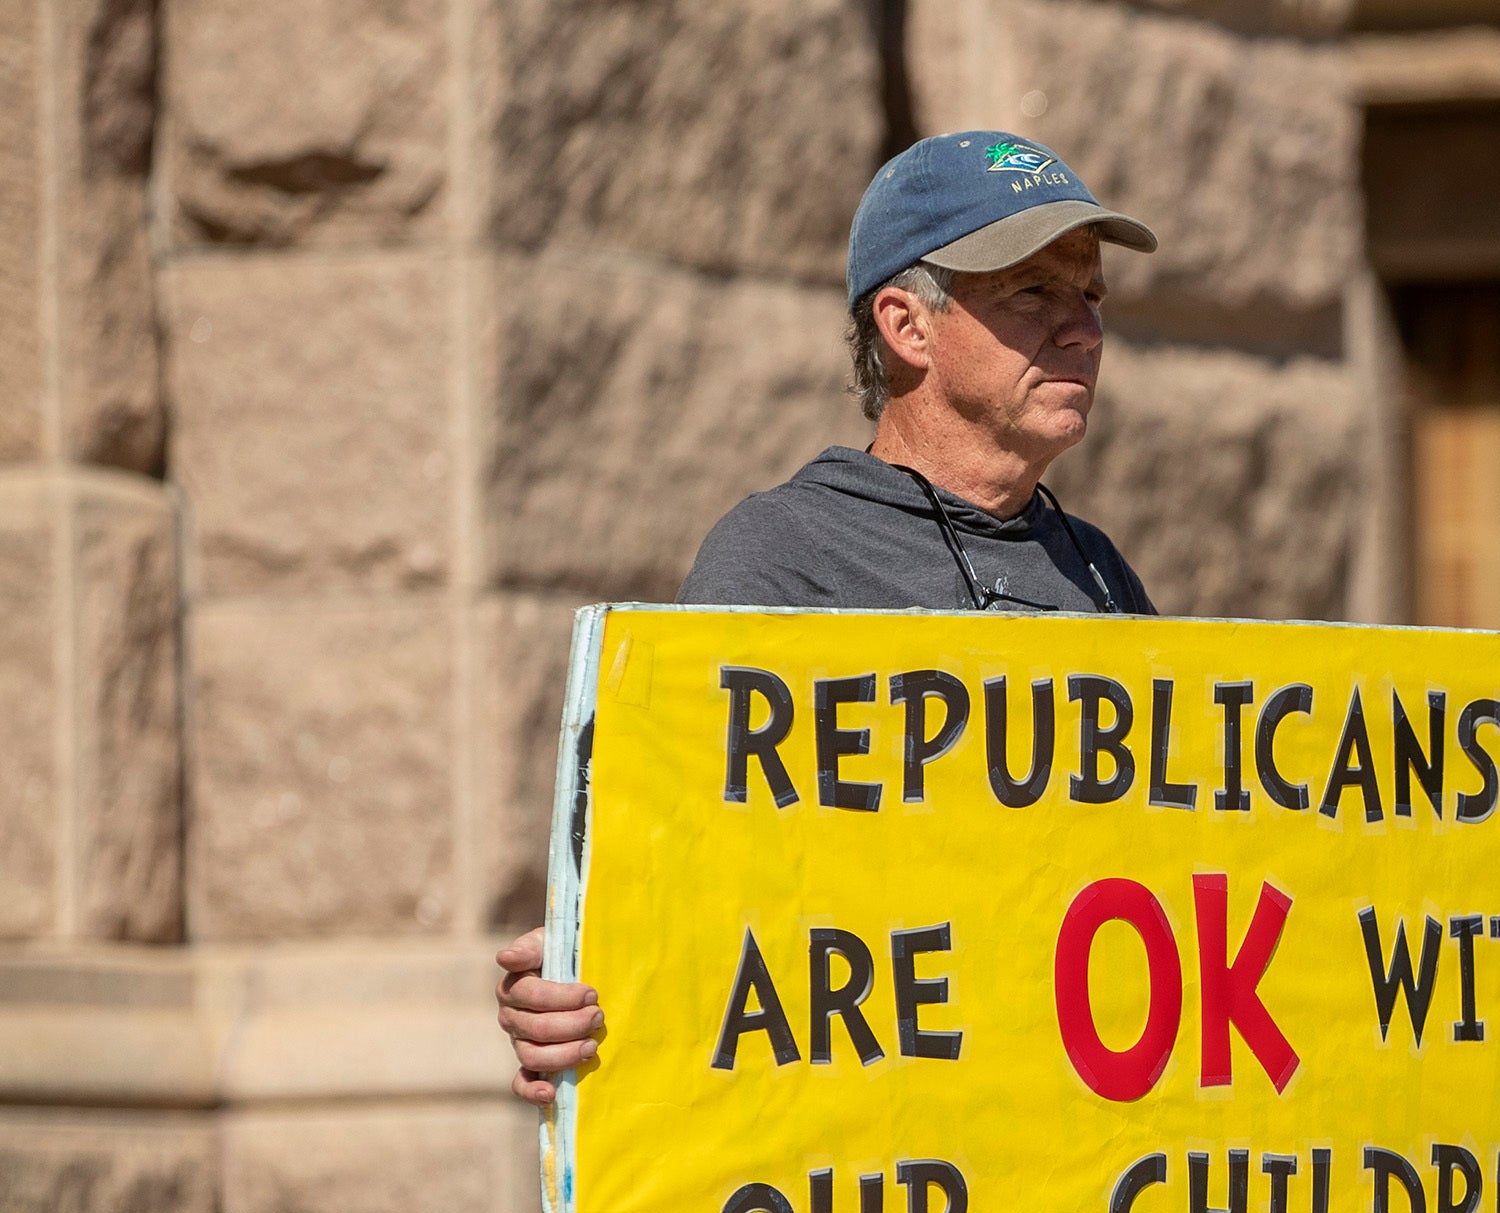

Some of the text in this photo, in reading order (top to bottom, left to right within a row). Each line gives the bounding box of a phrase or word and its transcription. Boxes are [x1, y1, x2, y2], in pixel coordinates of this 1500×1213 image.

[1010, 173, 1069, 193] NAPLES
[711, 920, 964, 1071] ARE
[1055, 873, 1301, 1102] OK
